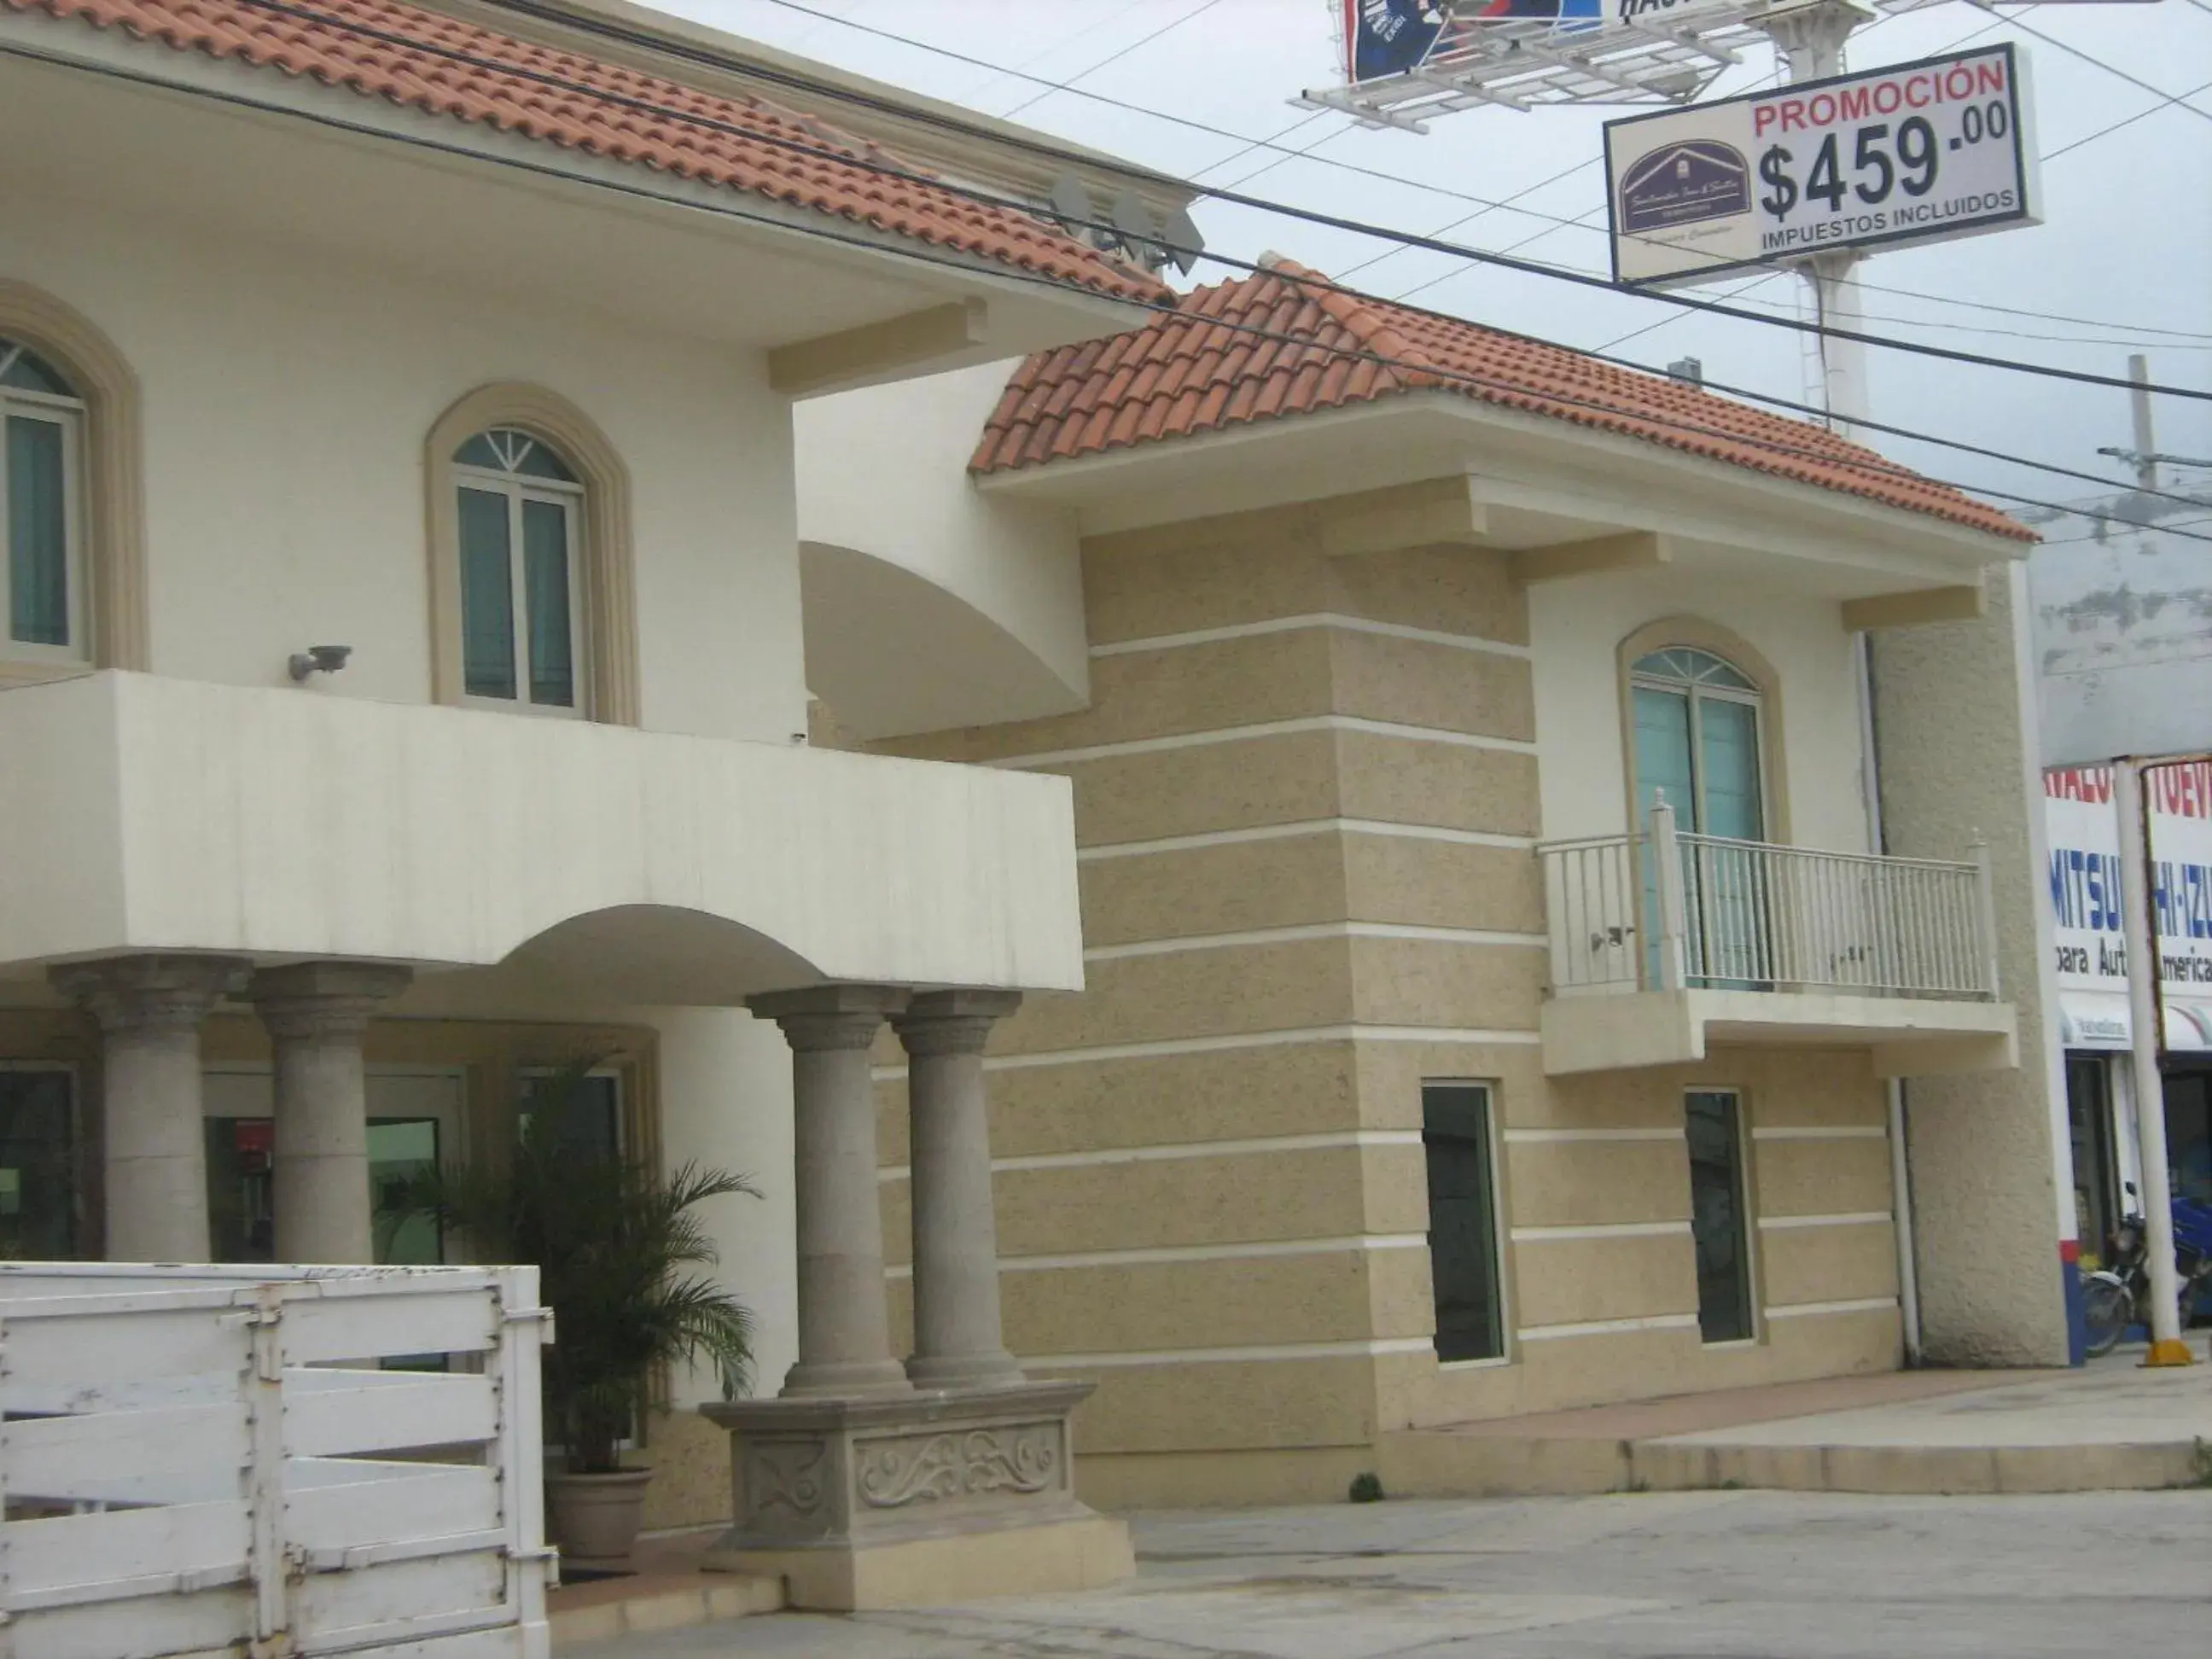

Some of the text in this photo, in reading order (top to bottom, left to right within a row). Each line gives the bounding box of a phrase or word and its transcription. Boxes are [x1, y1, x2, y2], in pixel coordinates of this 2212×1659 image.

[1754, 61, 2005, 137] PROMOCIÓN
[1761, 212, 1887, 250] IMPUESTOS
[1893, 189, 2015, 226] INCLUIDOS
